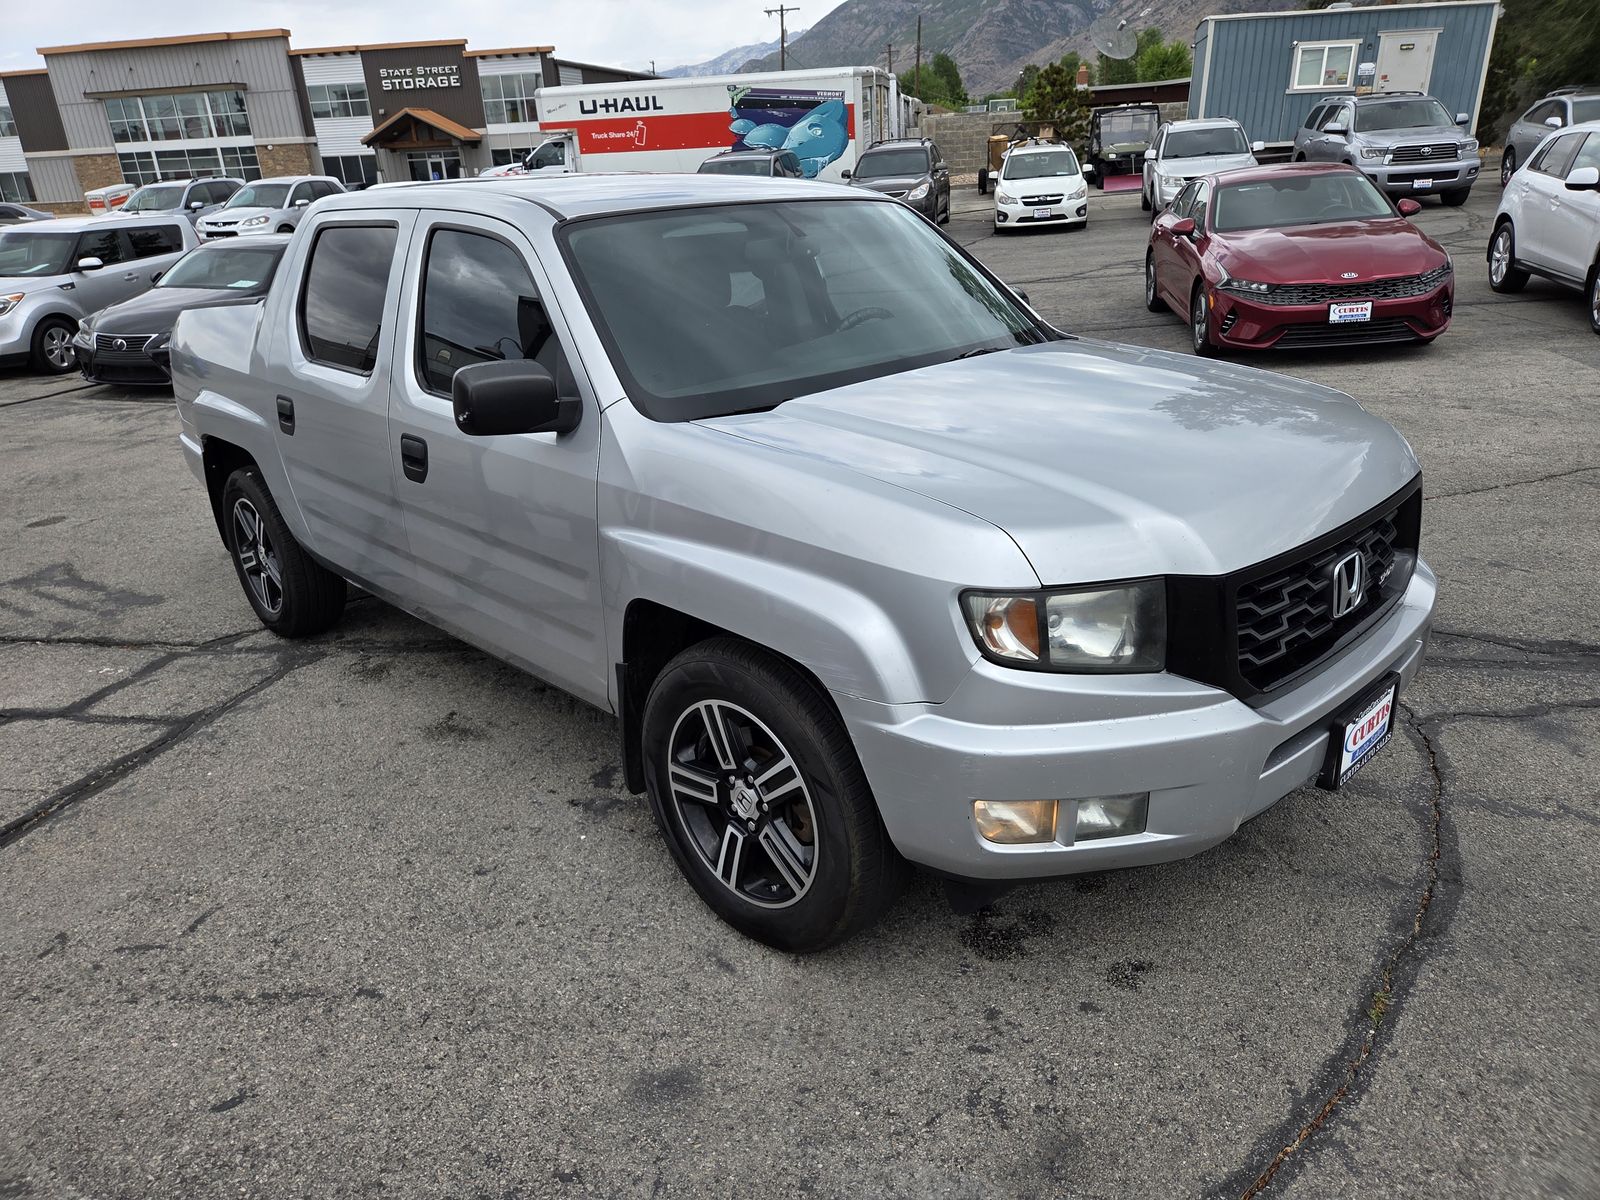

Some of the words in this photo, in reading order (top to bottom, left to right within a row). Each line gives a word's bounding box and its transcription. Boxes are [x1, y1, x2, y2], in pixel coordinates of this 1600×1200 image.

[380, 68, 413, 76] STATE
[416, 66, 458, 75] STREET
[382, 76, 460, 90] STORAGE
[579, 96, 664, 114] U-HAUL
[591, 132, 608, 140] Truck
[608, 131, 626, 139] Share
[626, 130, 640, 139] 24/7
[1352, 701, 1391, 747] CURTIS
[1340, 761, 1362, 787] CURTIS
[1360, 747, 1376, 768] AUTO
[1375, 731, 1393, 752] SALES
